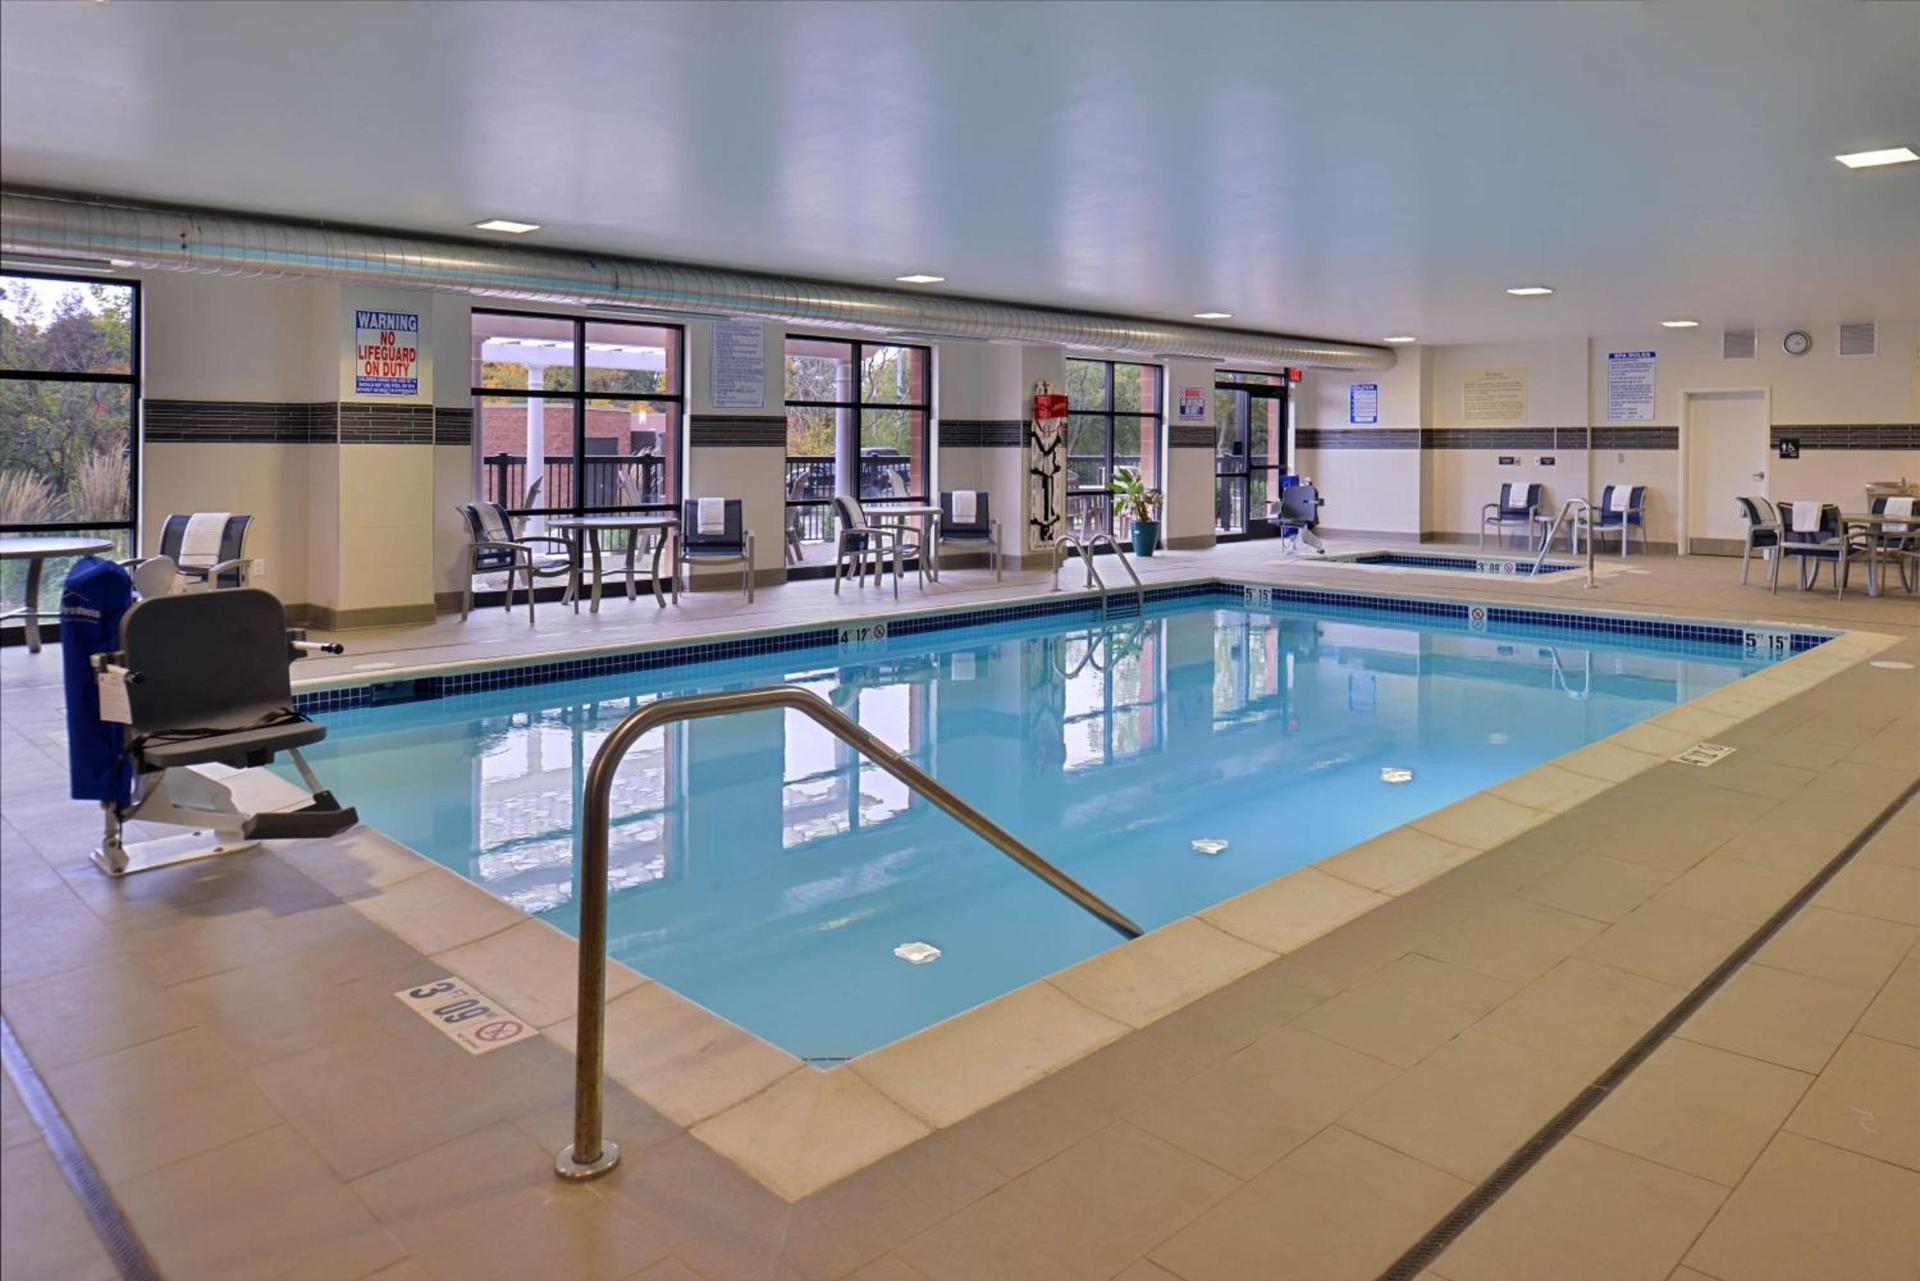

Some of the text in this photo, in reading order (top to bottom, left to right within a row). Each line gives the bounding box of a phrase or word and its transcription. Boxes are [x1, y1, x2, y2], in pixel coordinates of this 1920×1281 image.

[358, 312, 417, 331] WARNING
[380, 331, 396, 346] NO
[358, 345, 416, 362] LIFEGUARD
[365, 361, 410, 377] ON DUTY
[841, 630, 848, 643] 4
[1745, 633, 1757, 648] 5
[409, 982, 455, 999] 3
